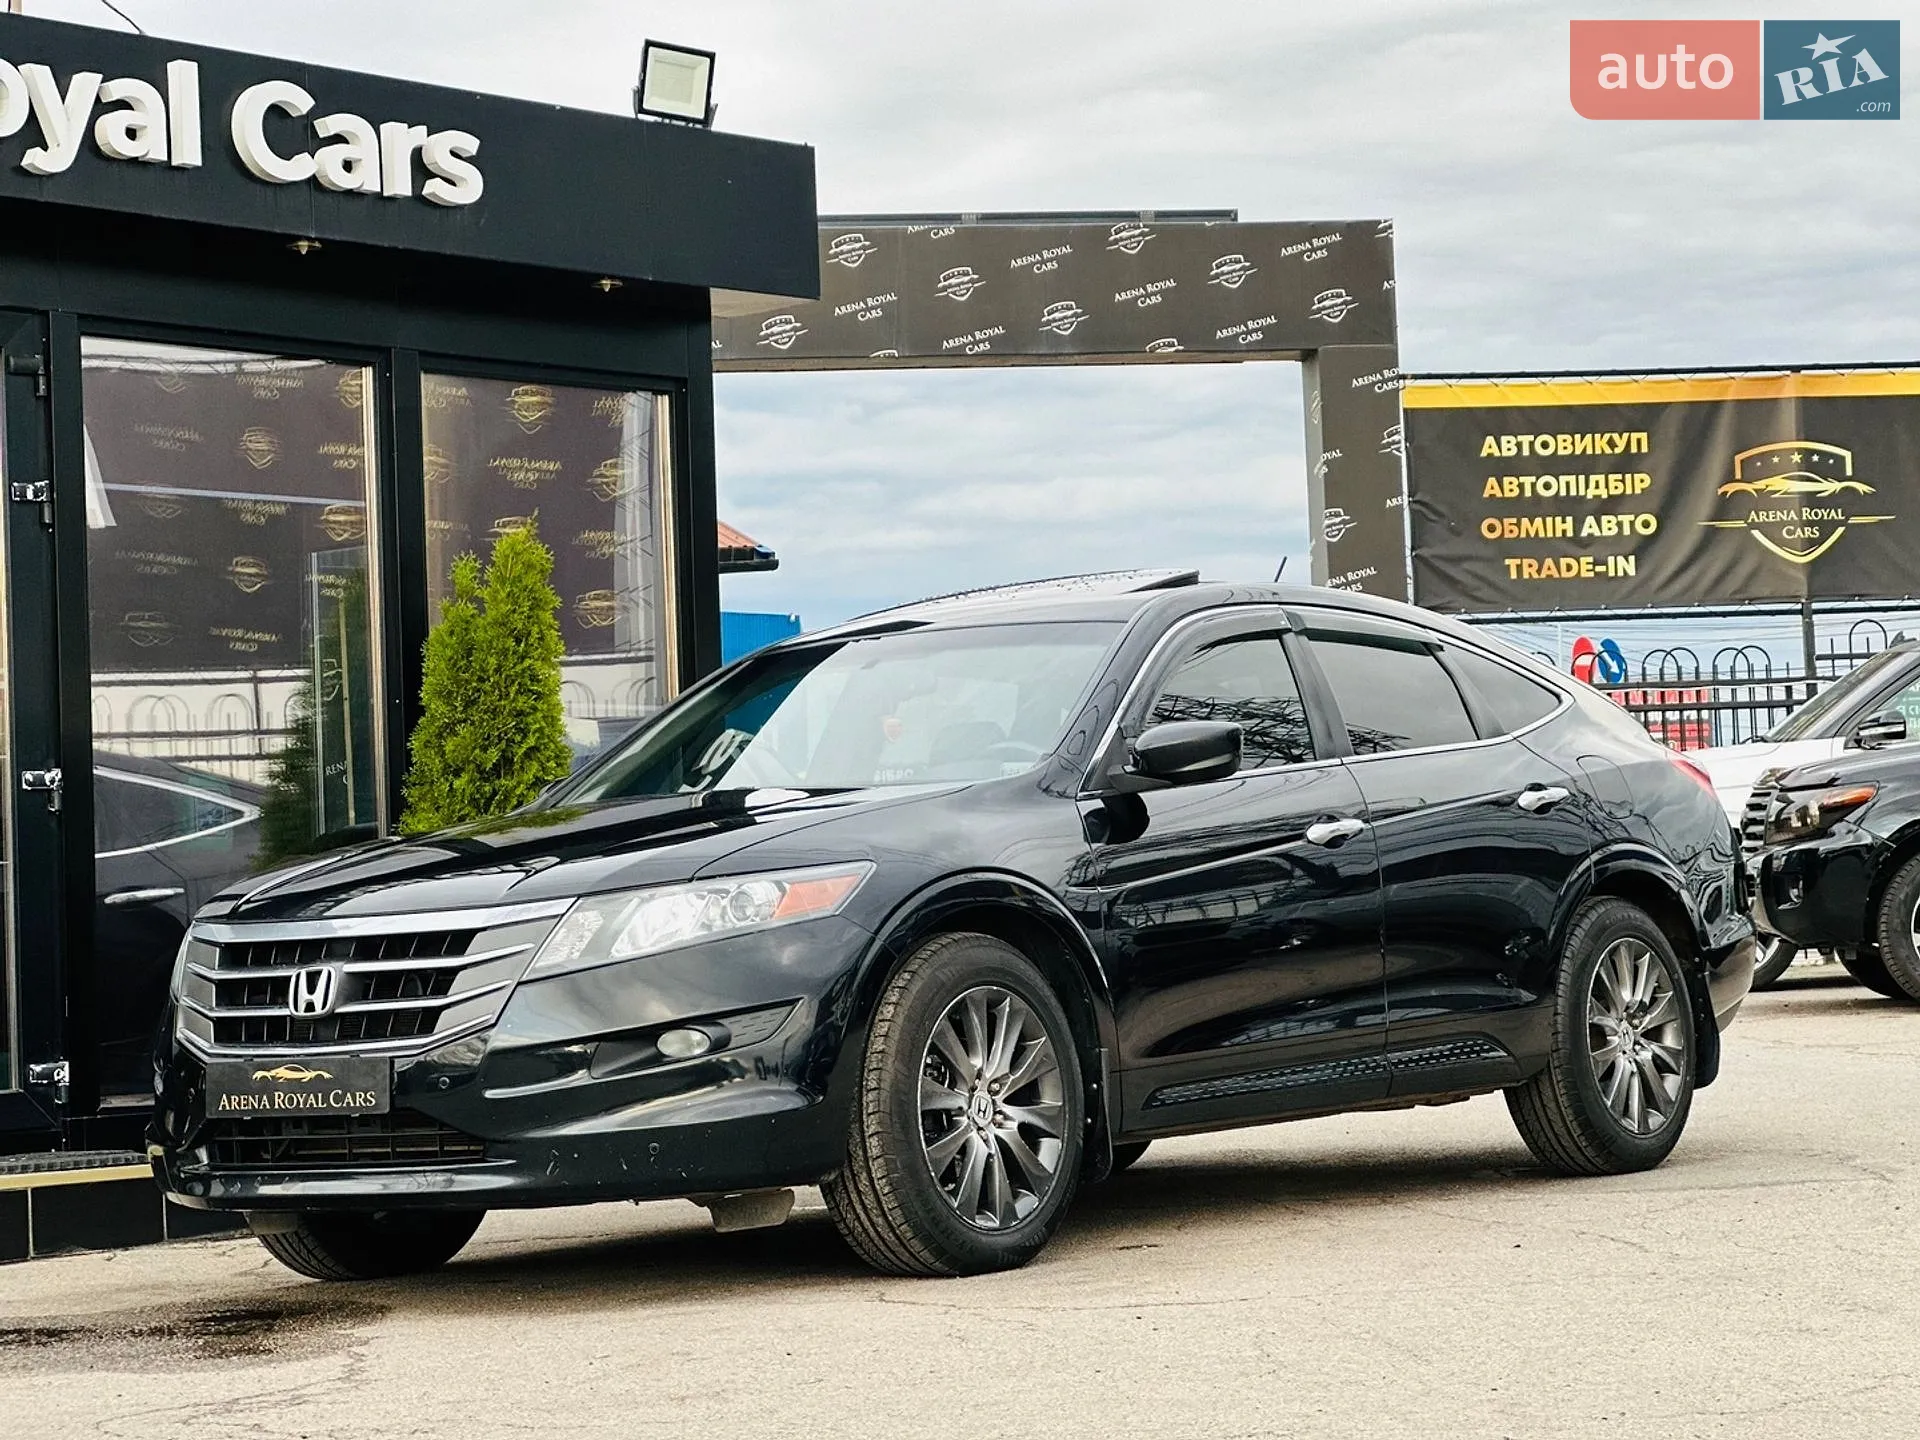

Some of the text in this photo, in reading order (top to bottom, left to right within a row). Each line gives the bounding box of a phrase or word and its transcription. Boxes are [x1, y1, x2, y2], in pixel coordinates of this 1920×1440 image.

[231, 80, 484, 207] Cars
[1281, 232, 1343, 257] ARENA ROYAL
[1303, 248, 1328, 262] CARS
[1010, 244, 1073, 269] ARENA ROYAL
[1033, 260, 1059, 274] CARS
[1114, 278, 1177, 303] ARENA ROYAL
[1137, 293, 1162, 307] CARS
[834, 292, 898, 316] ARENA ROYAL
[857, 307, 883, 321] CARS
[942, 325, 1006, 350] ARENA ROYAL
[1215, 315, 1278, 340] ARENA ROYAL
[1239, 331, 1264, 344] CARS
[965, 341, 991, 355] CARS
[1351, 372, 1383, 388] ARENA
[1374, 379, 1400, 393] CARS
[1480, 432, 1649, 457] АВТОВИКУП
[1482, 473, 1652, 499] АВТОПІДБІР
[1480, 513, 1658, 539] ОБМІН АВТО
[1747, 507, 1846, 523] ARENA ROYAL
[1782, 525, 1820, 539] CARS
[1347, 566, 1378, 581] ROYAL
[1505, 555, 1636, 581] TRADE-IN
[218, 1089, 376, 1111] ARENA ROYAL CARS
